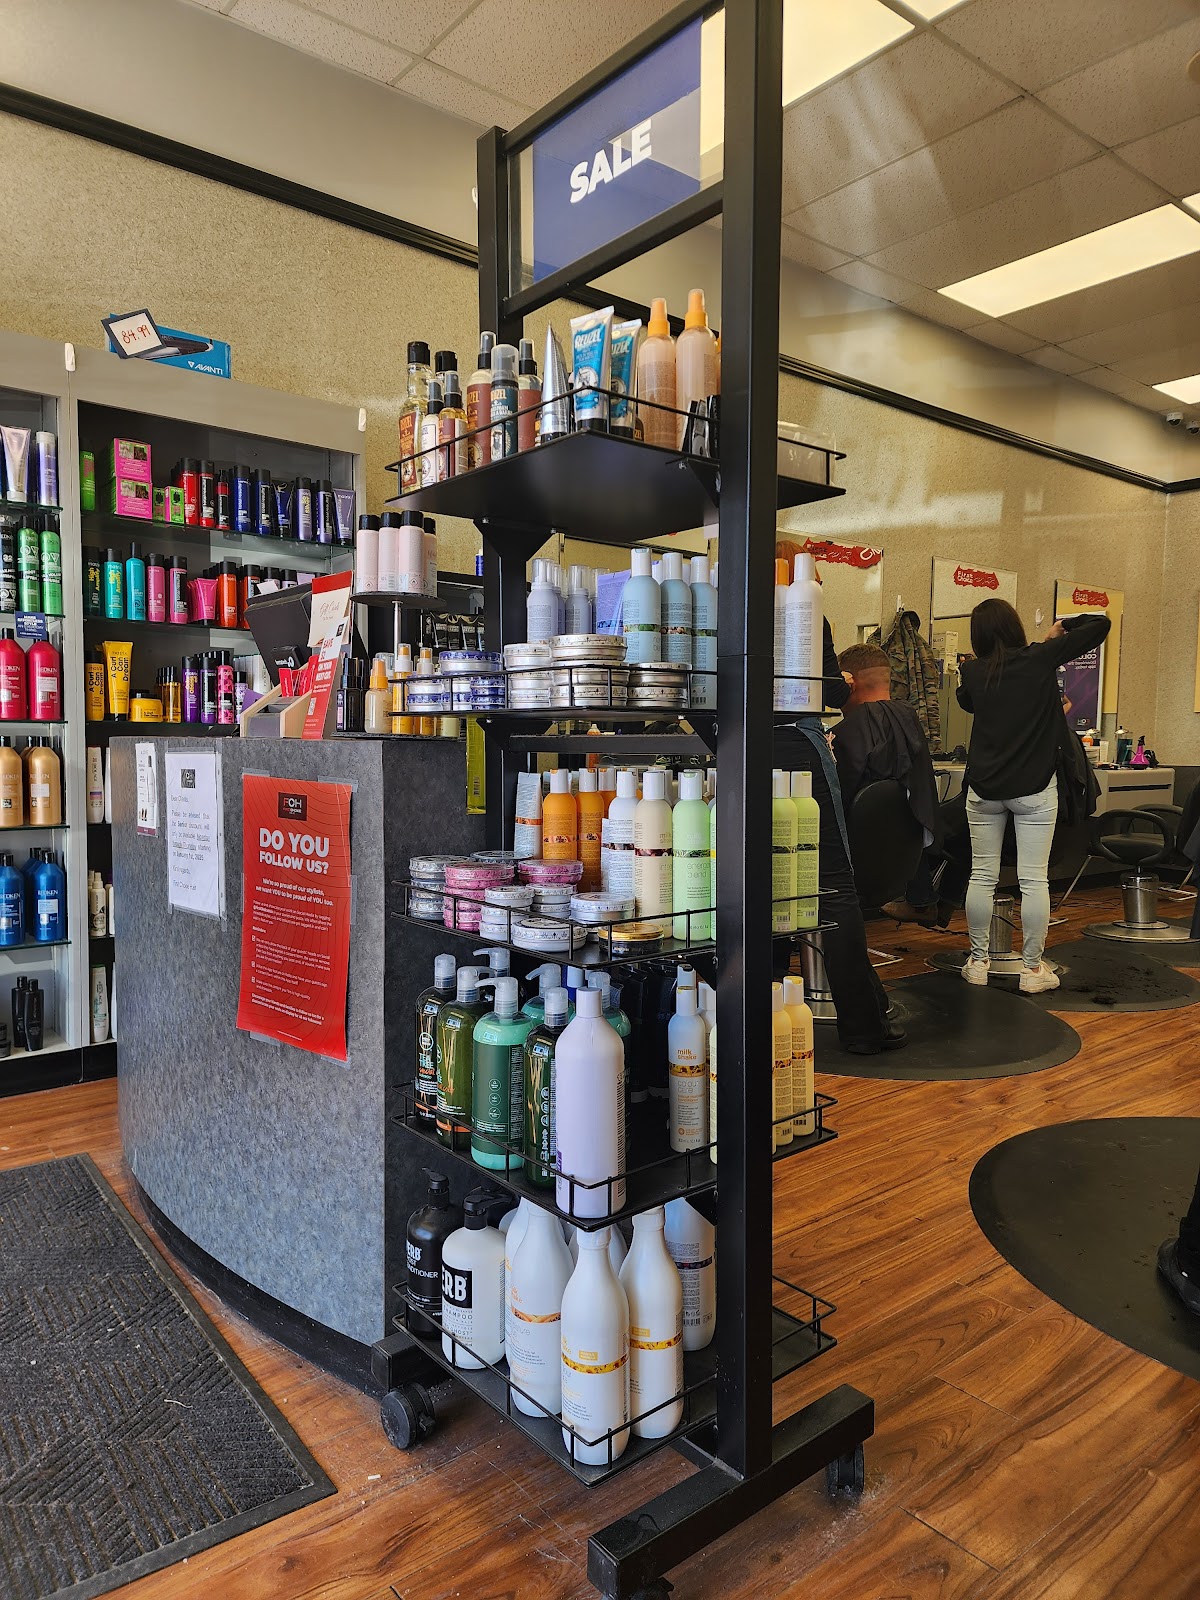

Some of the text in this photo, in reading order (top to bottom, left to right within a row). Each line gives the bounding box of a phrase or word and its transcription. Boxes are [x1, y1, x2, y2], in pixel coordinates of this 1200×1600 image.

[570, 118, 652, 203] SALE
[121, 324, 151, 344] 84.99
[575, 329, 602, 349] REUZEL
[195, 363, 223, 375] AVANTI
[260, 828, 329, 858] DO YOU
[260, 851, 329, 874] FOLLOW US?
[306, 888, 325, 896] stylists,
[407, 1240, 420, 1260] ERB
[442, 1264, 467, 1302] RB
